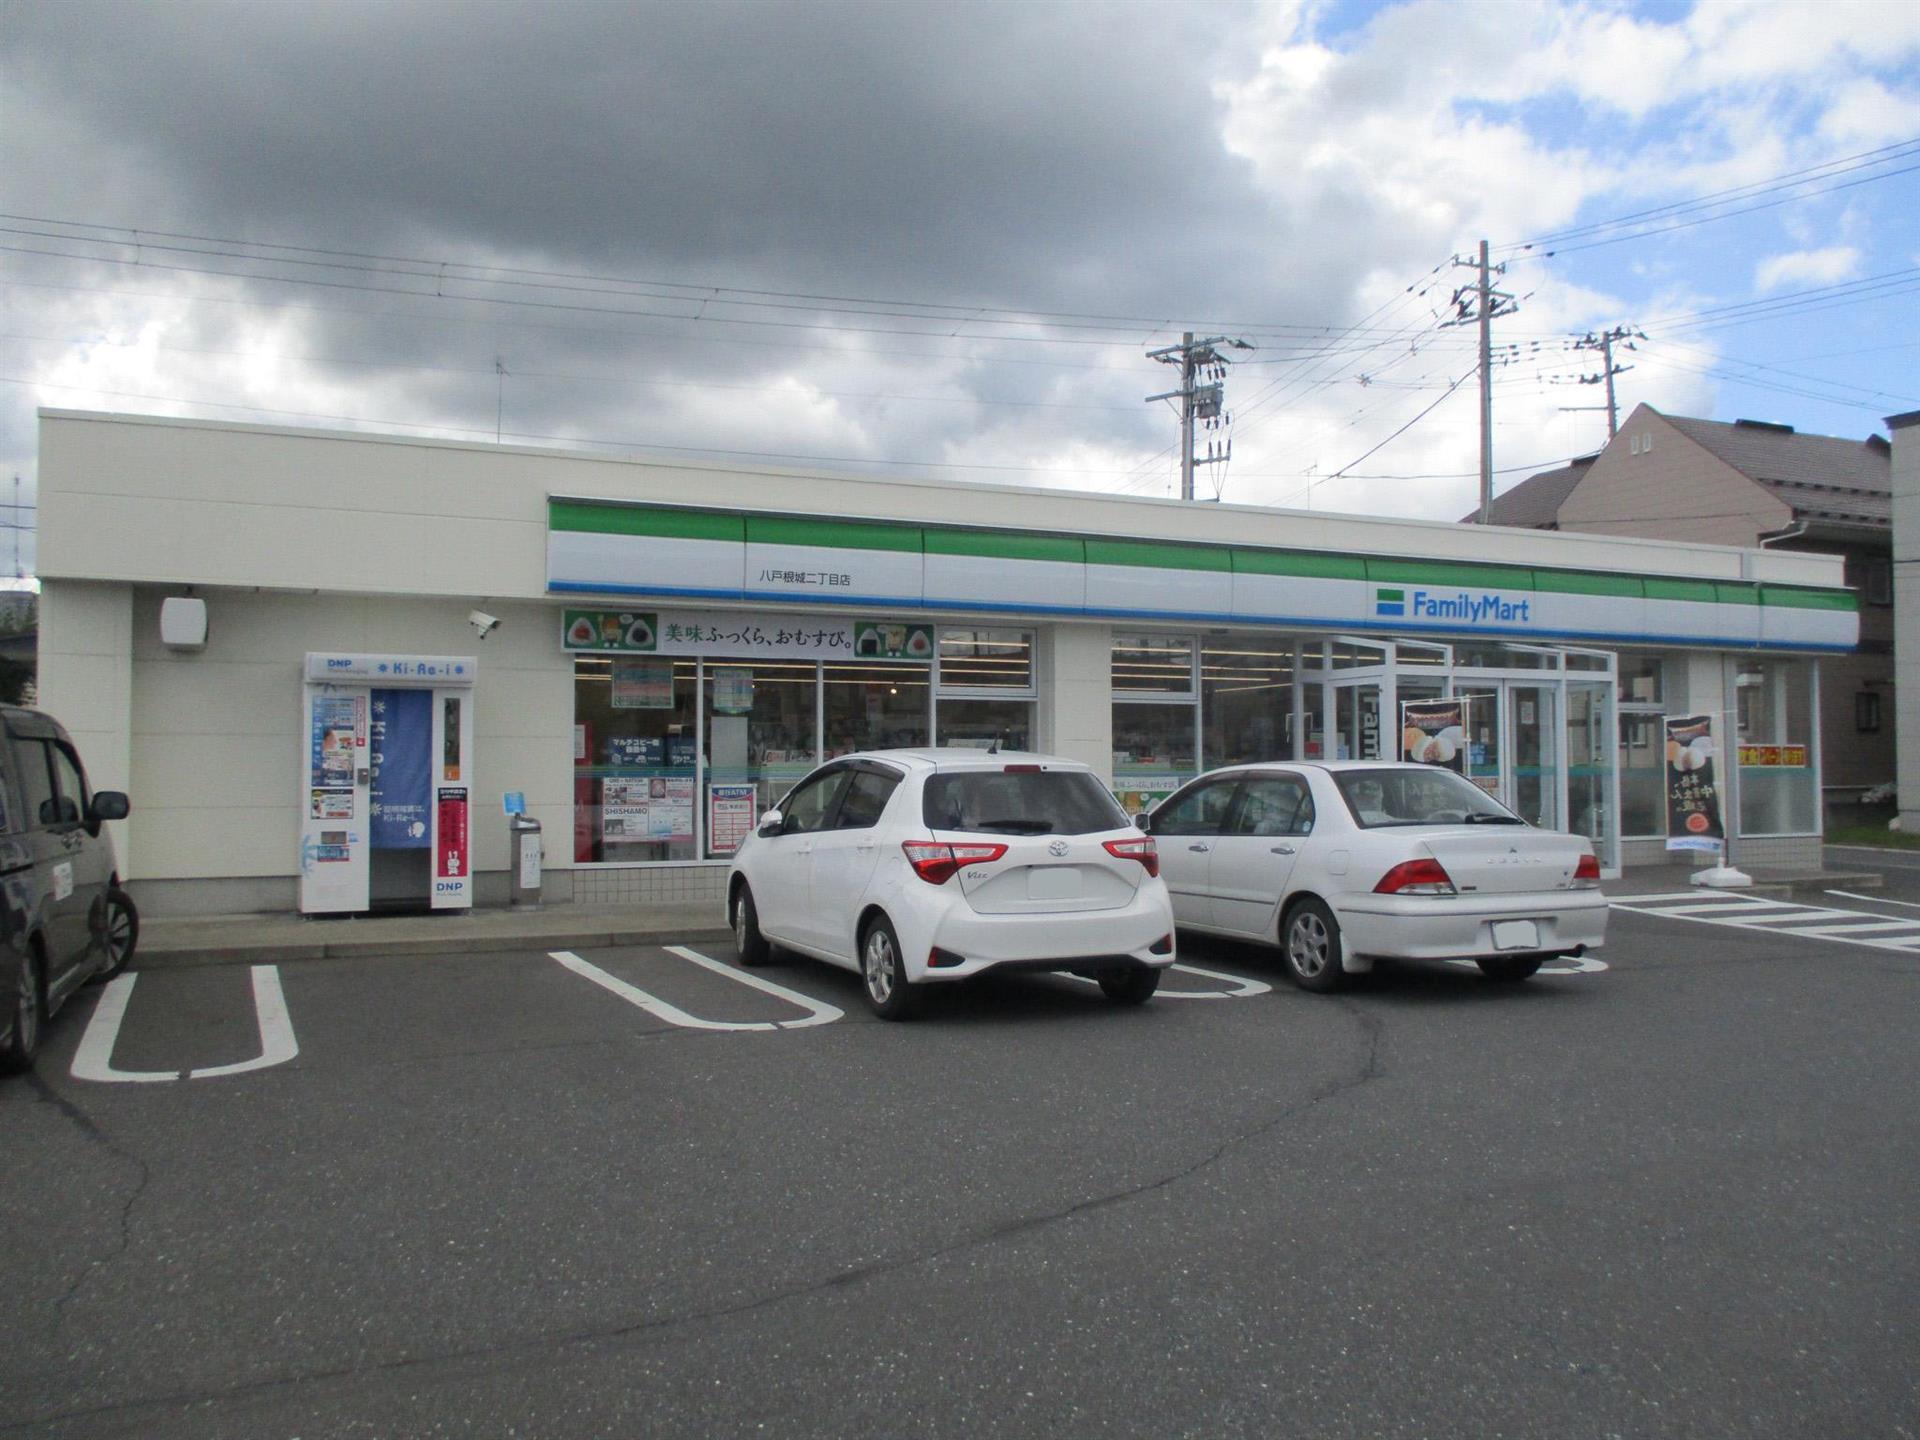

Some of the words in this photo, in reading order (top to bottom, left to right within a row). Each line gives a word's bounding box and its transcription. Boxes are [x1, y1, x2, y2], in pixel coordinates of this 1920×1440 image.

[760, 569, 851, 586] 八戸根城二丁目店
[1413, 591, 1529, 622] FamilyMart
[665, 623, 852, 649] 美味ふっくら、おむすび。
[327, 659, 352, 667] DNP
[605, 807, 648, 815] SHISHAMO
[437, 883, 463, 891] DNP
